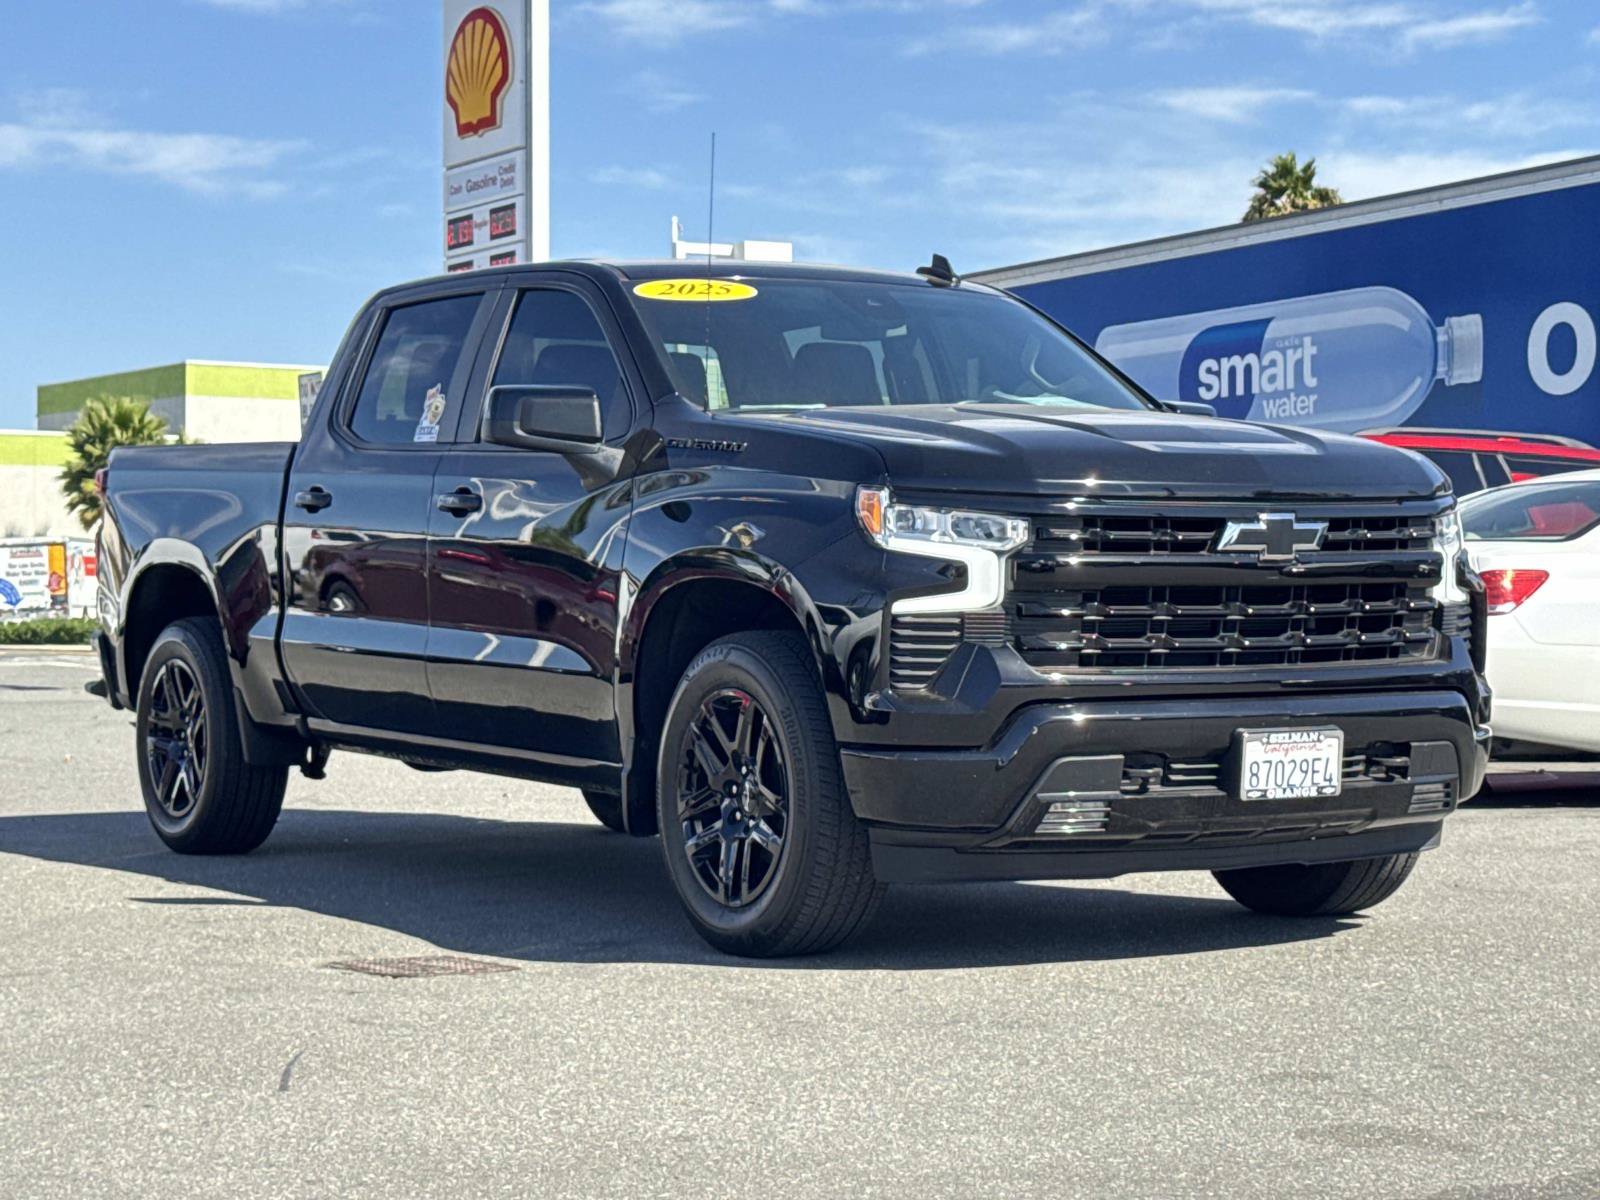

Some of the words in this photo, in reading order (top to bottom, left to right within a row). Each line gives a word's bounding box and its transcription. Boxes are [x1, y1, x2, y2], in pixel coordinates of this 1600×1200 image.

[466, 174, 498, 193] Gasoline
[657, 283, 733, 296] 2025
[1198, 336, 1318, 400] smart
[1262, 392, 1318, 419] water
[1269, 732, 1319, 743] SELMAN
[1249, 757, 1334, 789] 87029E4
[1266, 787, 1318, 799] ORANGE
